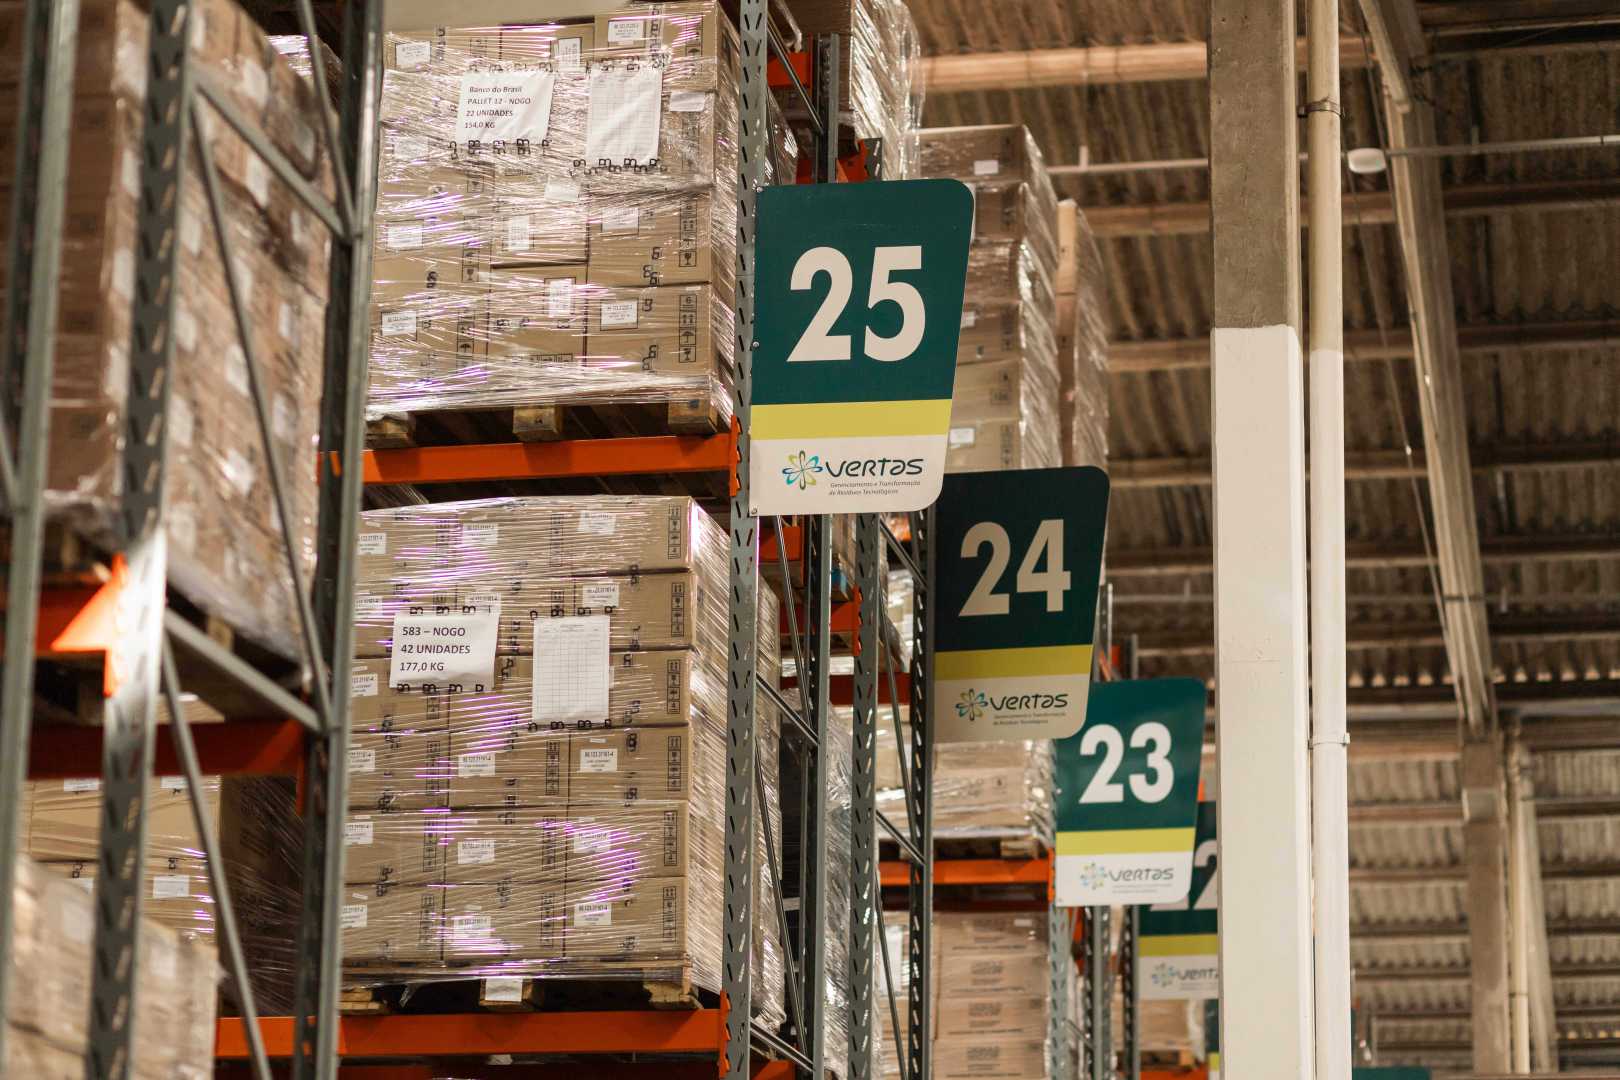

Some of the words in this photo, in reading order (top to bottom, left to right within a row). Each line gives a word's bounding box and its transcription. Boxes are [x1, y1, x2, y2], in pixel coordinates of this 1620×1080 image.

[485, 121, 495, 129] KG
[786, 245, 926, 362] 25
[958, 518, 1072, 617] 24
[401, 644, 413, 654] 42
[416, 645, 471, 654] UNIDADES
[402, 626, 421, 636] 583
[433, 627, 466, 636] NOGO
[400, 662, 427, 672] 177,0
[430, 662, 444, 671] KG
[1079, 721, 1174, 803] 23
[1150, 839, 1217, 911] 2
